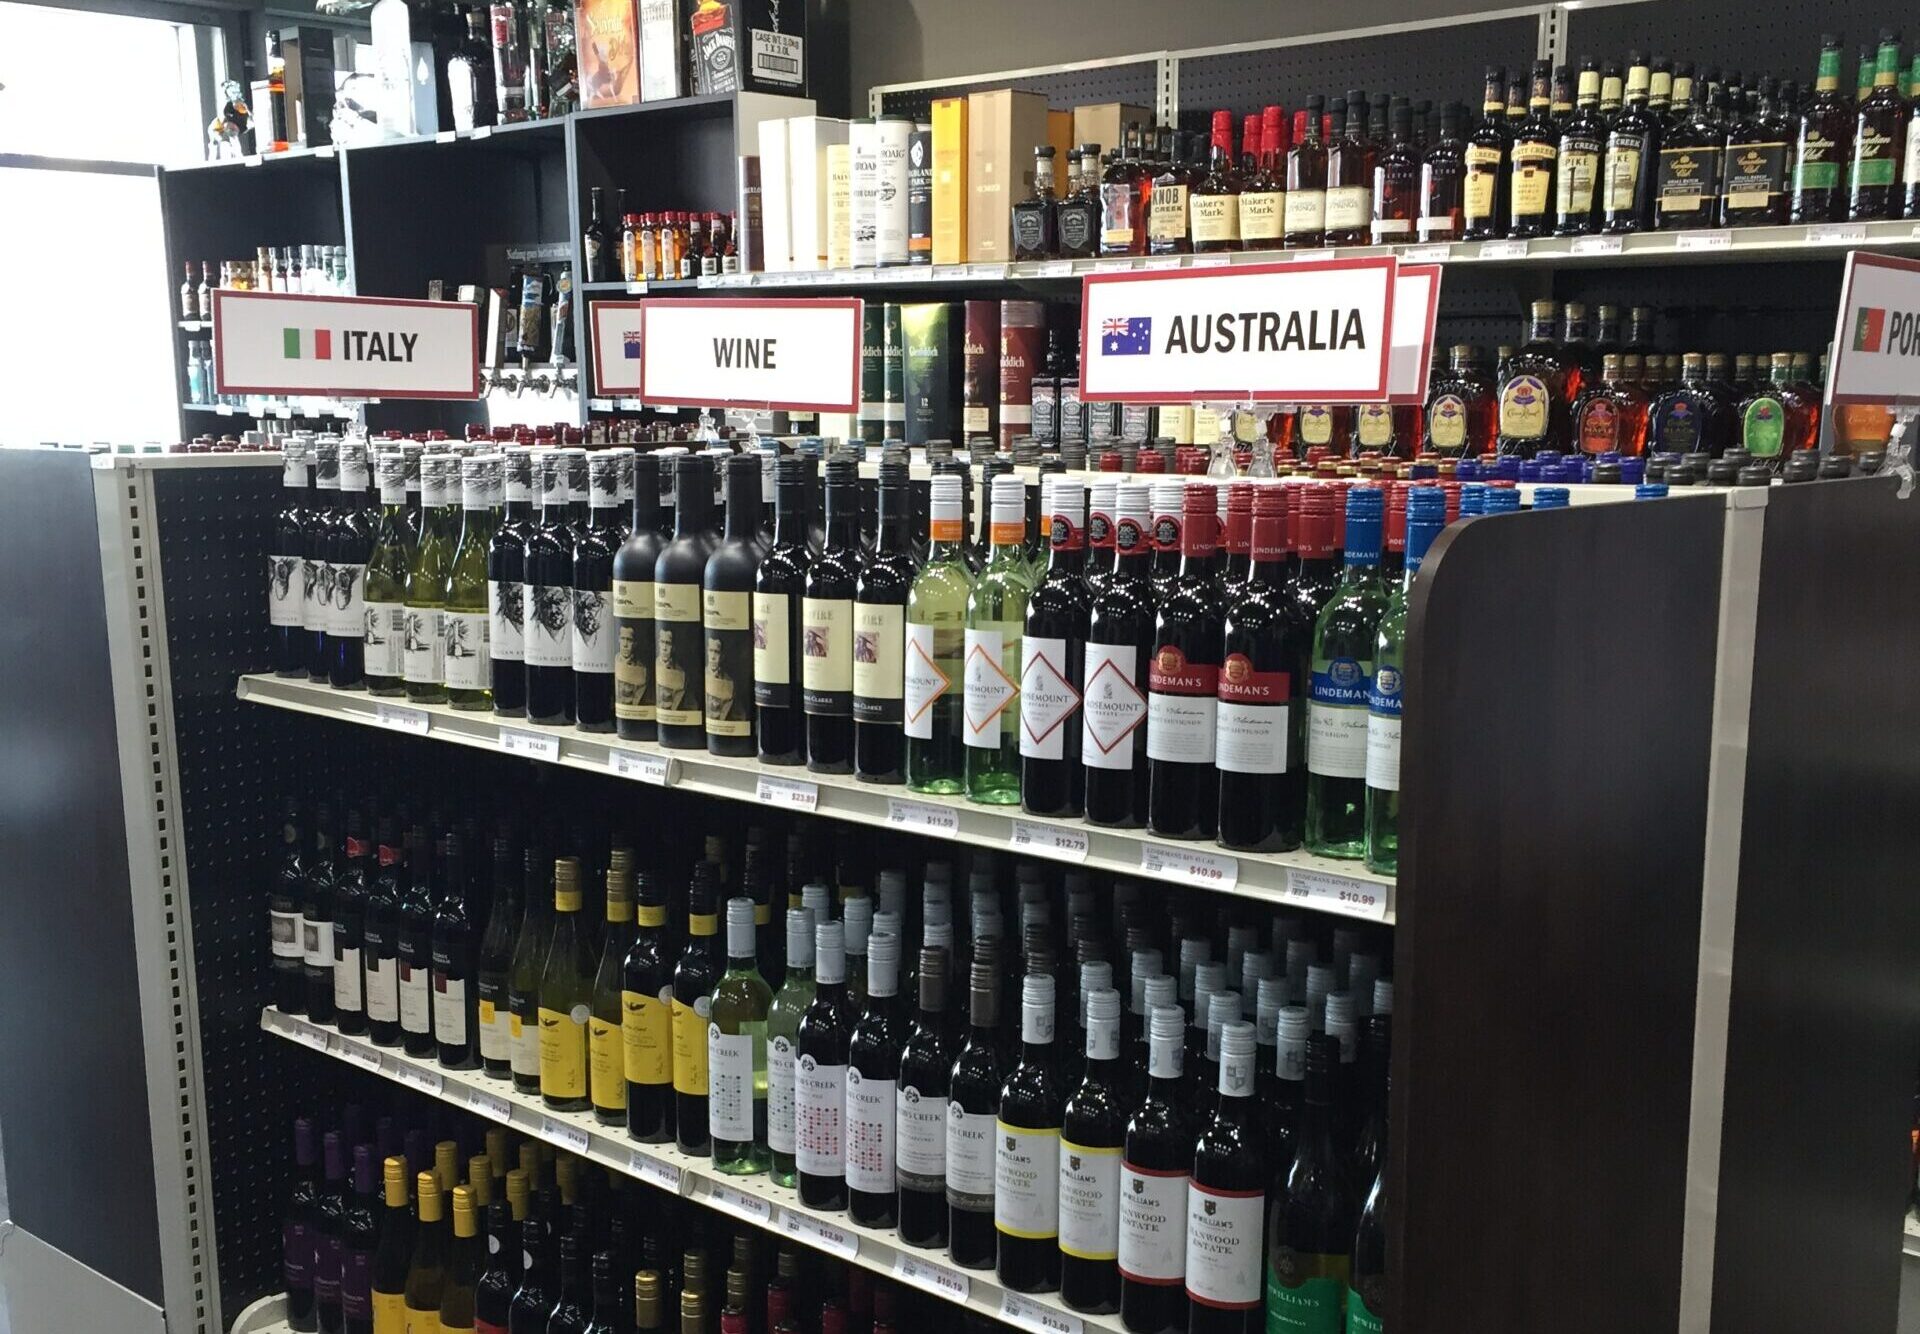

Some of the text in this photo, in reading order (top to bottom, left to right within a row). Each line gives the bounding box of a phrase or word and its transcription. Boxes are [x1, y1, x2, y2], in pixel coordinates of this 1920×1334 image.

[1152, 189, 1179, 205] KNOB
[1193, 198, 1224, 208] Maker's
[1165, 308, 1366, 354] AUSTRALIA
[1887, 311, 1920, 357] POR
[344, 330, 418, 362] ITALY
[714, 338, 777, 370] WINE
[1314, 687, 1368, 699] LINDEMAN
[1056, 838, 1085, 850] $12.79
[1190, 866, 1223, 879] $10.99
[1339, 891, 1375, 906] $10.99
[810, 1080, 836, 1089] CREEK
[856, 1094, 881, 1104] CREEK
[913, 1112, 942, 1122] CREEK
